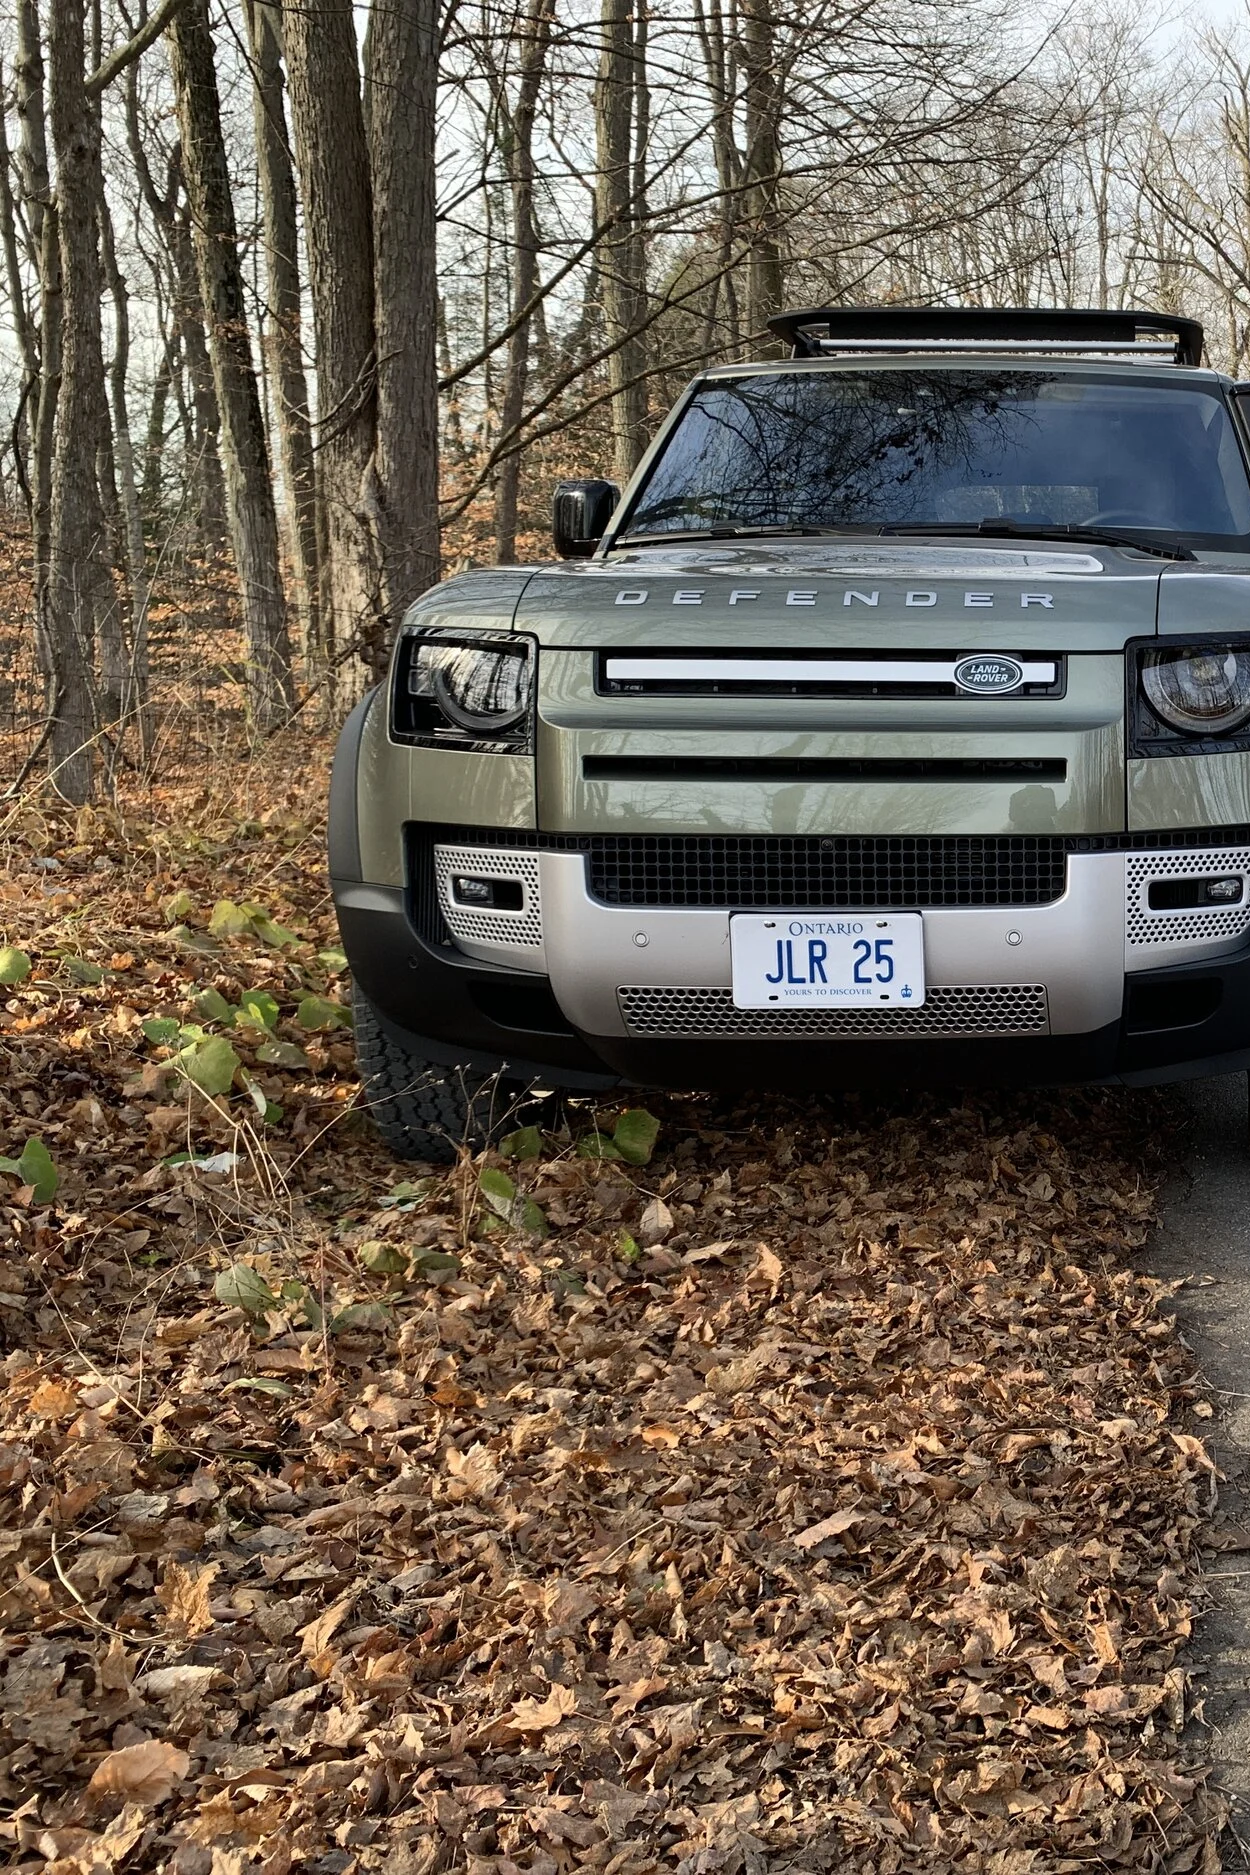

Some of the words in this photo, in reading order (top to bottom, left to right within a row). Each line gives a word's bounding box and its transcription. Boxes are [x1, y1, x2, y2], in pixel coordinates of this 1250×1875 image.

[613, 589, 1056, 610] DEFENDER
[788, 921, 864, 937] ONTARIO
[765, 939, 828, 984] JLR
[852, 939, 894, 984] 25
[784, 988, 813, 996] YOURS
[815, 988, 827, 996] TO
[829, 988, 873, 996] DISCOVER
